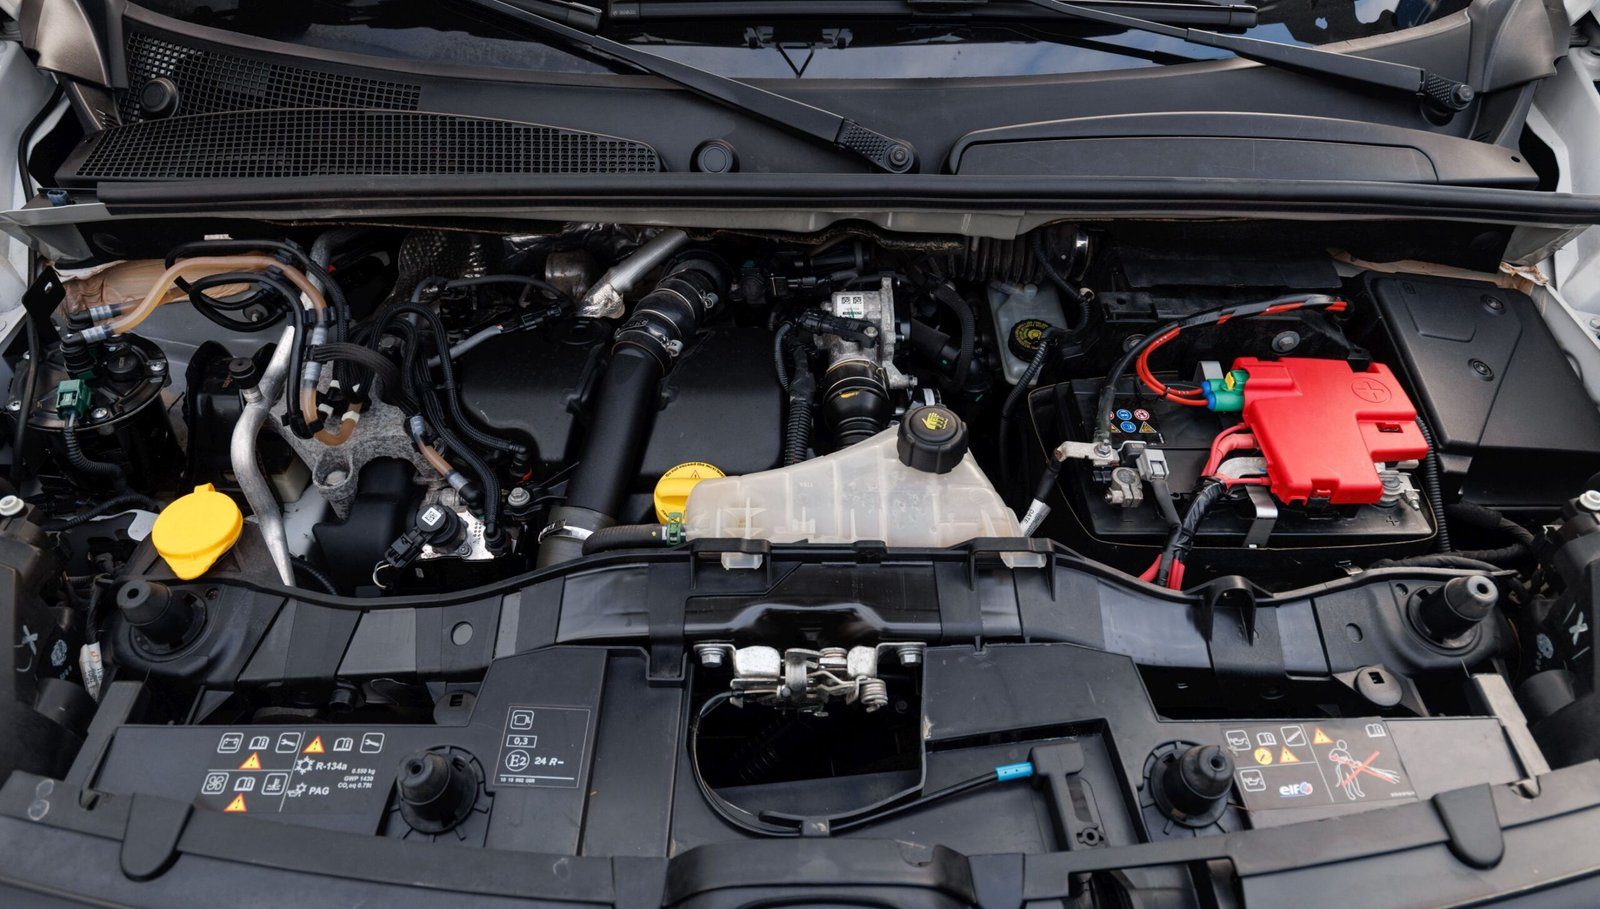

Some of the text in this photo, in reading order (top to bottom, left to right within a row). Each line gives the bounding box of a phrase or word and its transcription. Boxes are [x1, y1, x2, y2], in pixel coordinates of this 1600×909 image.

[513, 737, 529, 746] 0,3
[508, 754, 527, 767] E2
[534, 756, 547, 765] 24
[315, 761, 348, 771] R-134a
[308, 786, 330, 796] PAG
[1279, 783, 1301, 796] elf
